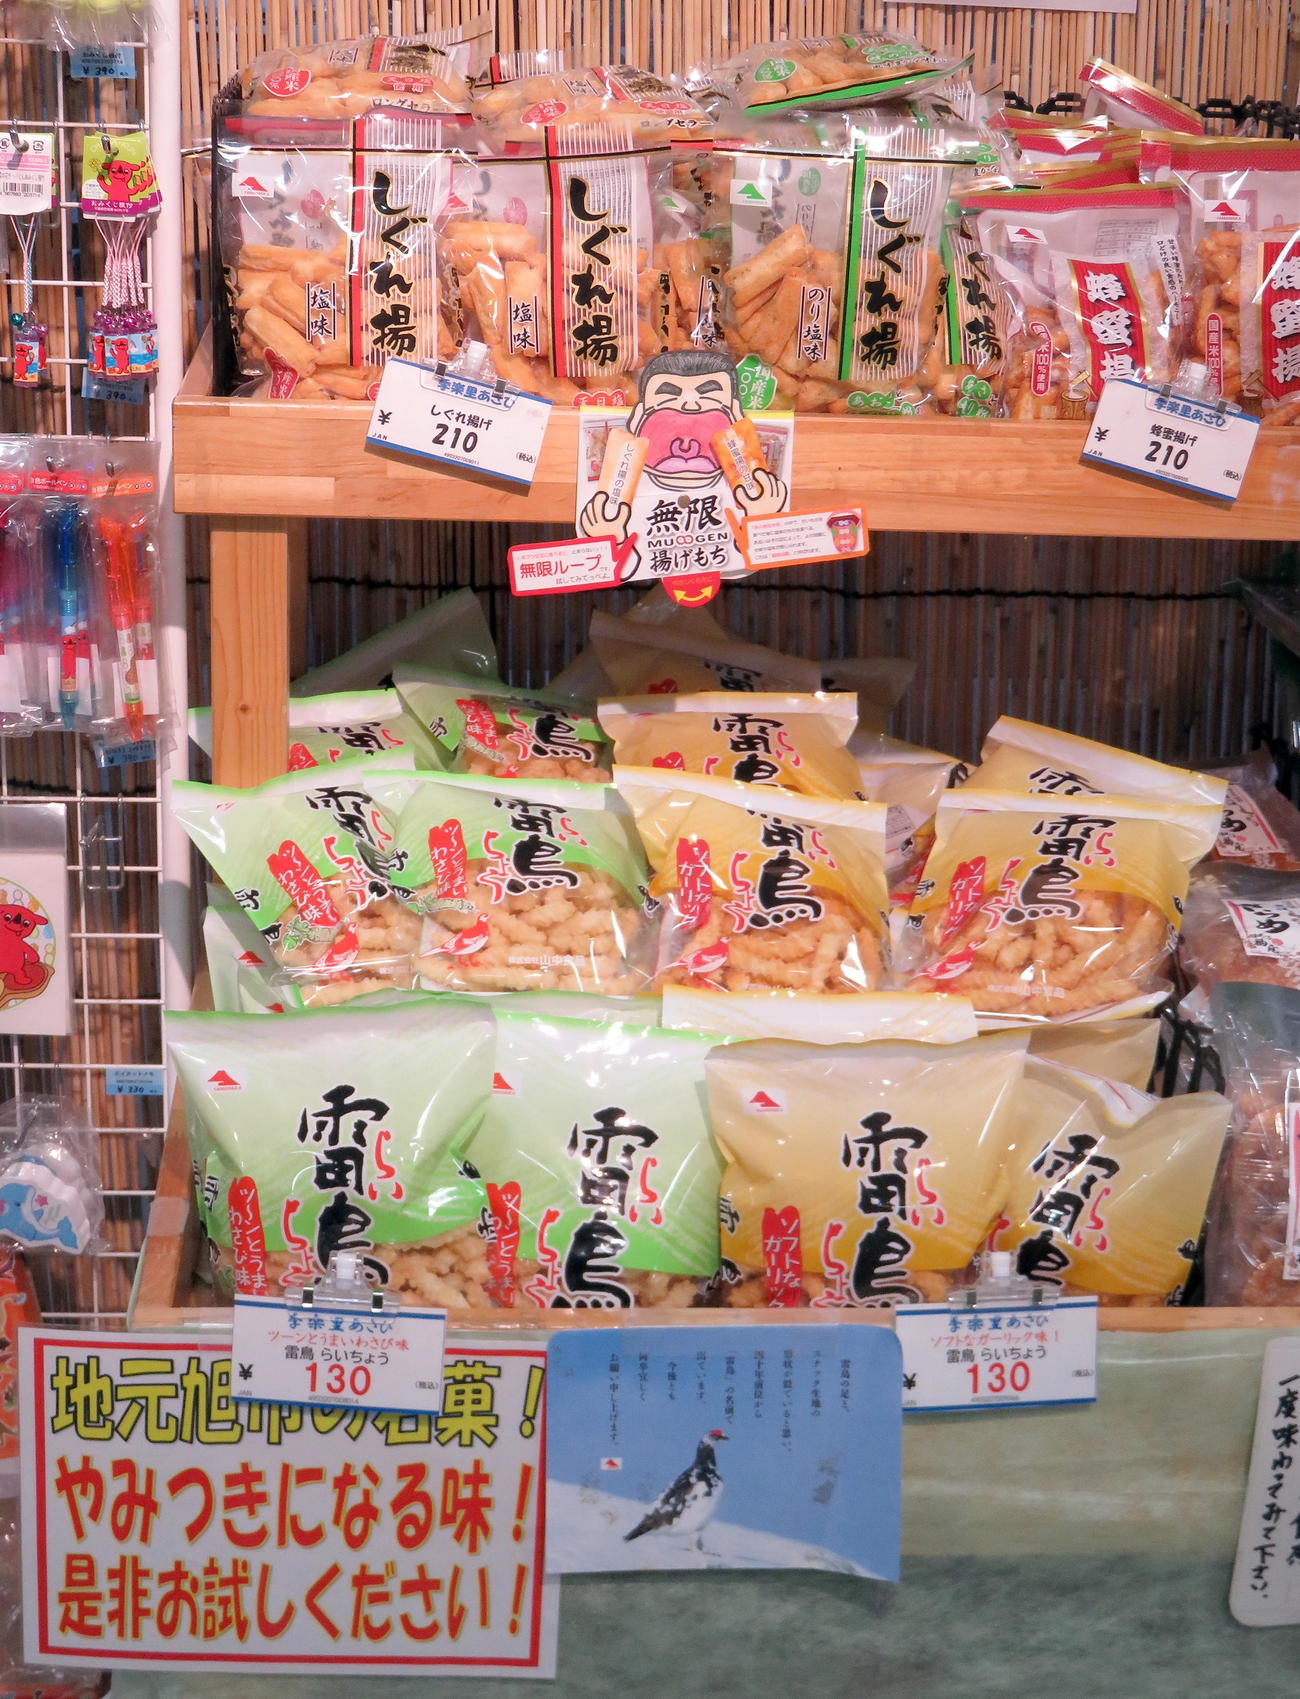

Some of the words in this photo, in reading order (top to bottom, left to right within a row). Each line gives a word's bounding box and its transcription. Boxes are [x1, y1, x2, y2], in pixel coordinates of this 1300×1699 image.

[369, 171, 428, 357] しぐれ揚
[570, 177, 628, 367] しぐれ揚
[859, 178, 921, 370] しぐれ揚
[309, 289, 332, 337] 塩味
[512, 302, 535, 350] 塩味
[803, 286, 827, 362] のり塩味
[430, 404, 493, 431] しぐれ揚げ
[432, 423, 478, 453] 210
[1150, 423, 1198, 447] 蜂蜜揚げ
[1144, 440, 1189, 470] 210
[647, 493, 724, 537] 無限
[519, 553, 602, 579] 無限ループ
[650, 545, 728, 573] 揚げもち
[297, 1084, 391, 1286] 雷鳥
[552, 1106, 660, 1308] 雷鳥
[842, 1111, 928, 1308] 雷鳥
[229, 1204, 252, 1286] わさび味
[780, 1218, 801, 1288] ソフトな
[267, 1330, 409, 1351] ツーンとうまいわさび味
[284, 1344, 315, 1361] 雷鳥
[320, 1348, 390, 1365] らいちょう
[946, 1348, 975, 1364] 雷鳥
[980, 1345, 1048, 1360] らいちょう
[304, 1362, 372, 1396] 130
[966, 1361, 1031, 1394] 130
[54, 1454, 535, 1555] やみつきになる味！
[1250, 1373, 1300, 1599] 一度味わってみて下さい。
[56, 1552, 529, 1643] 是非お試しください！
